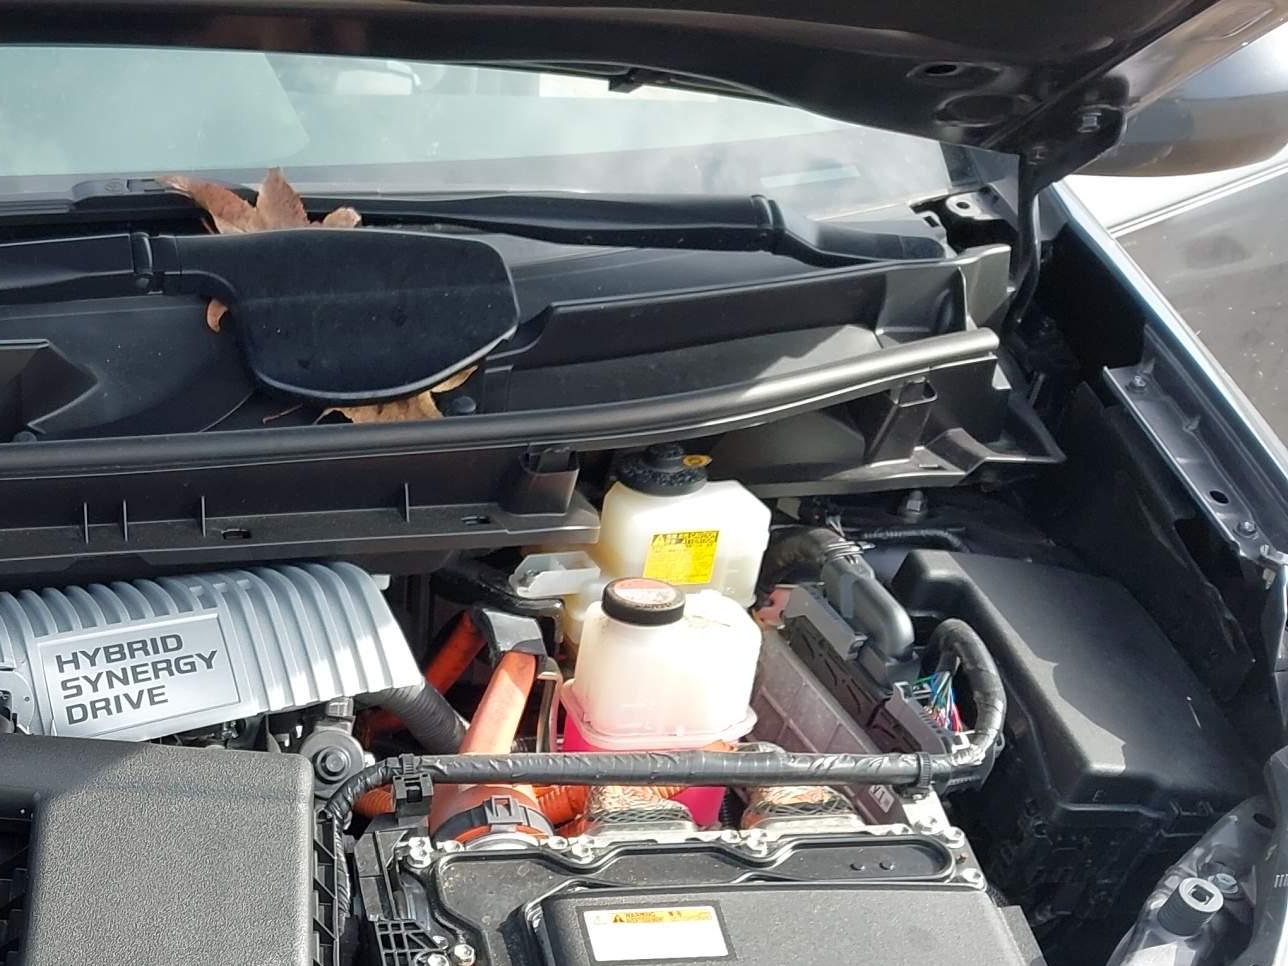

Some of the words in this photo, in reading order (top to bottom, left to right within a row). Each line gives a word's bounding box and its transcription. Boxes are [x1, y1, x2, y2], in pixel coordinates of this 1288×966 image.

[55, 634, 183, 673] HYBRID
[61, 650, 218, 700] SYNERGY
[66, 685, 169, 725] DRIVE
